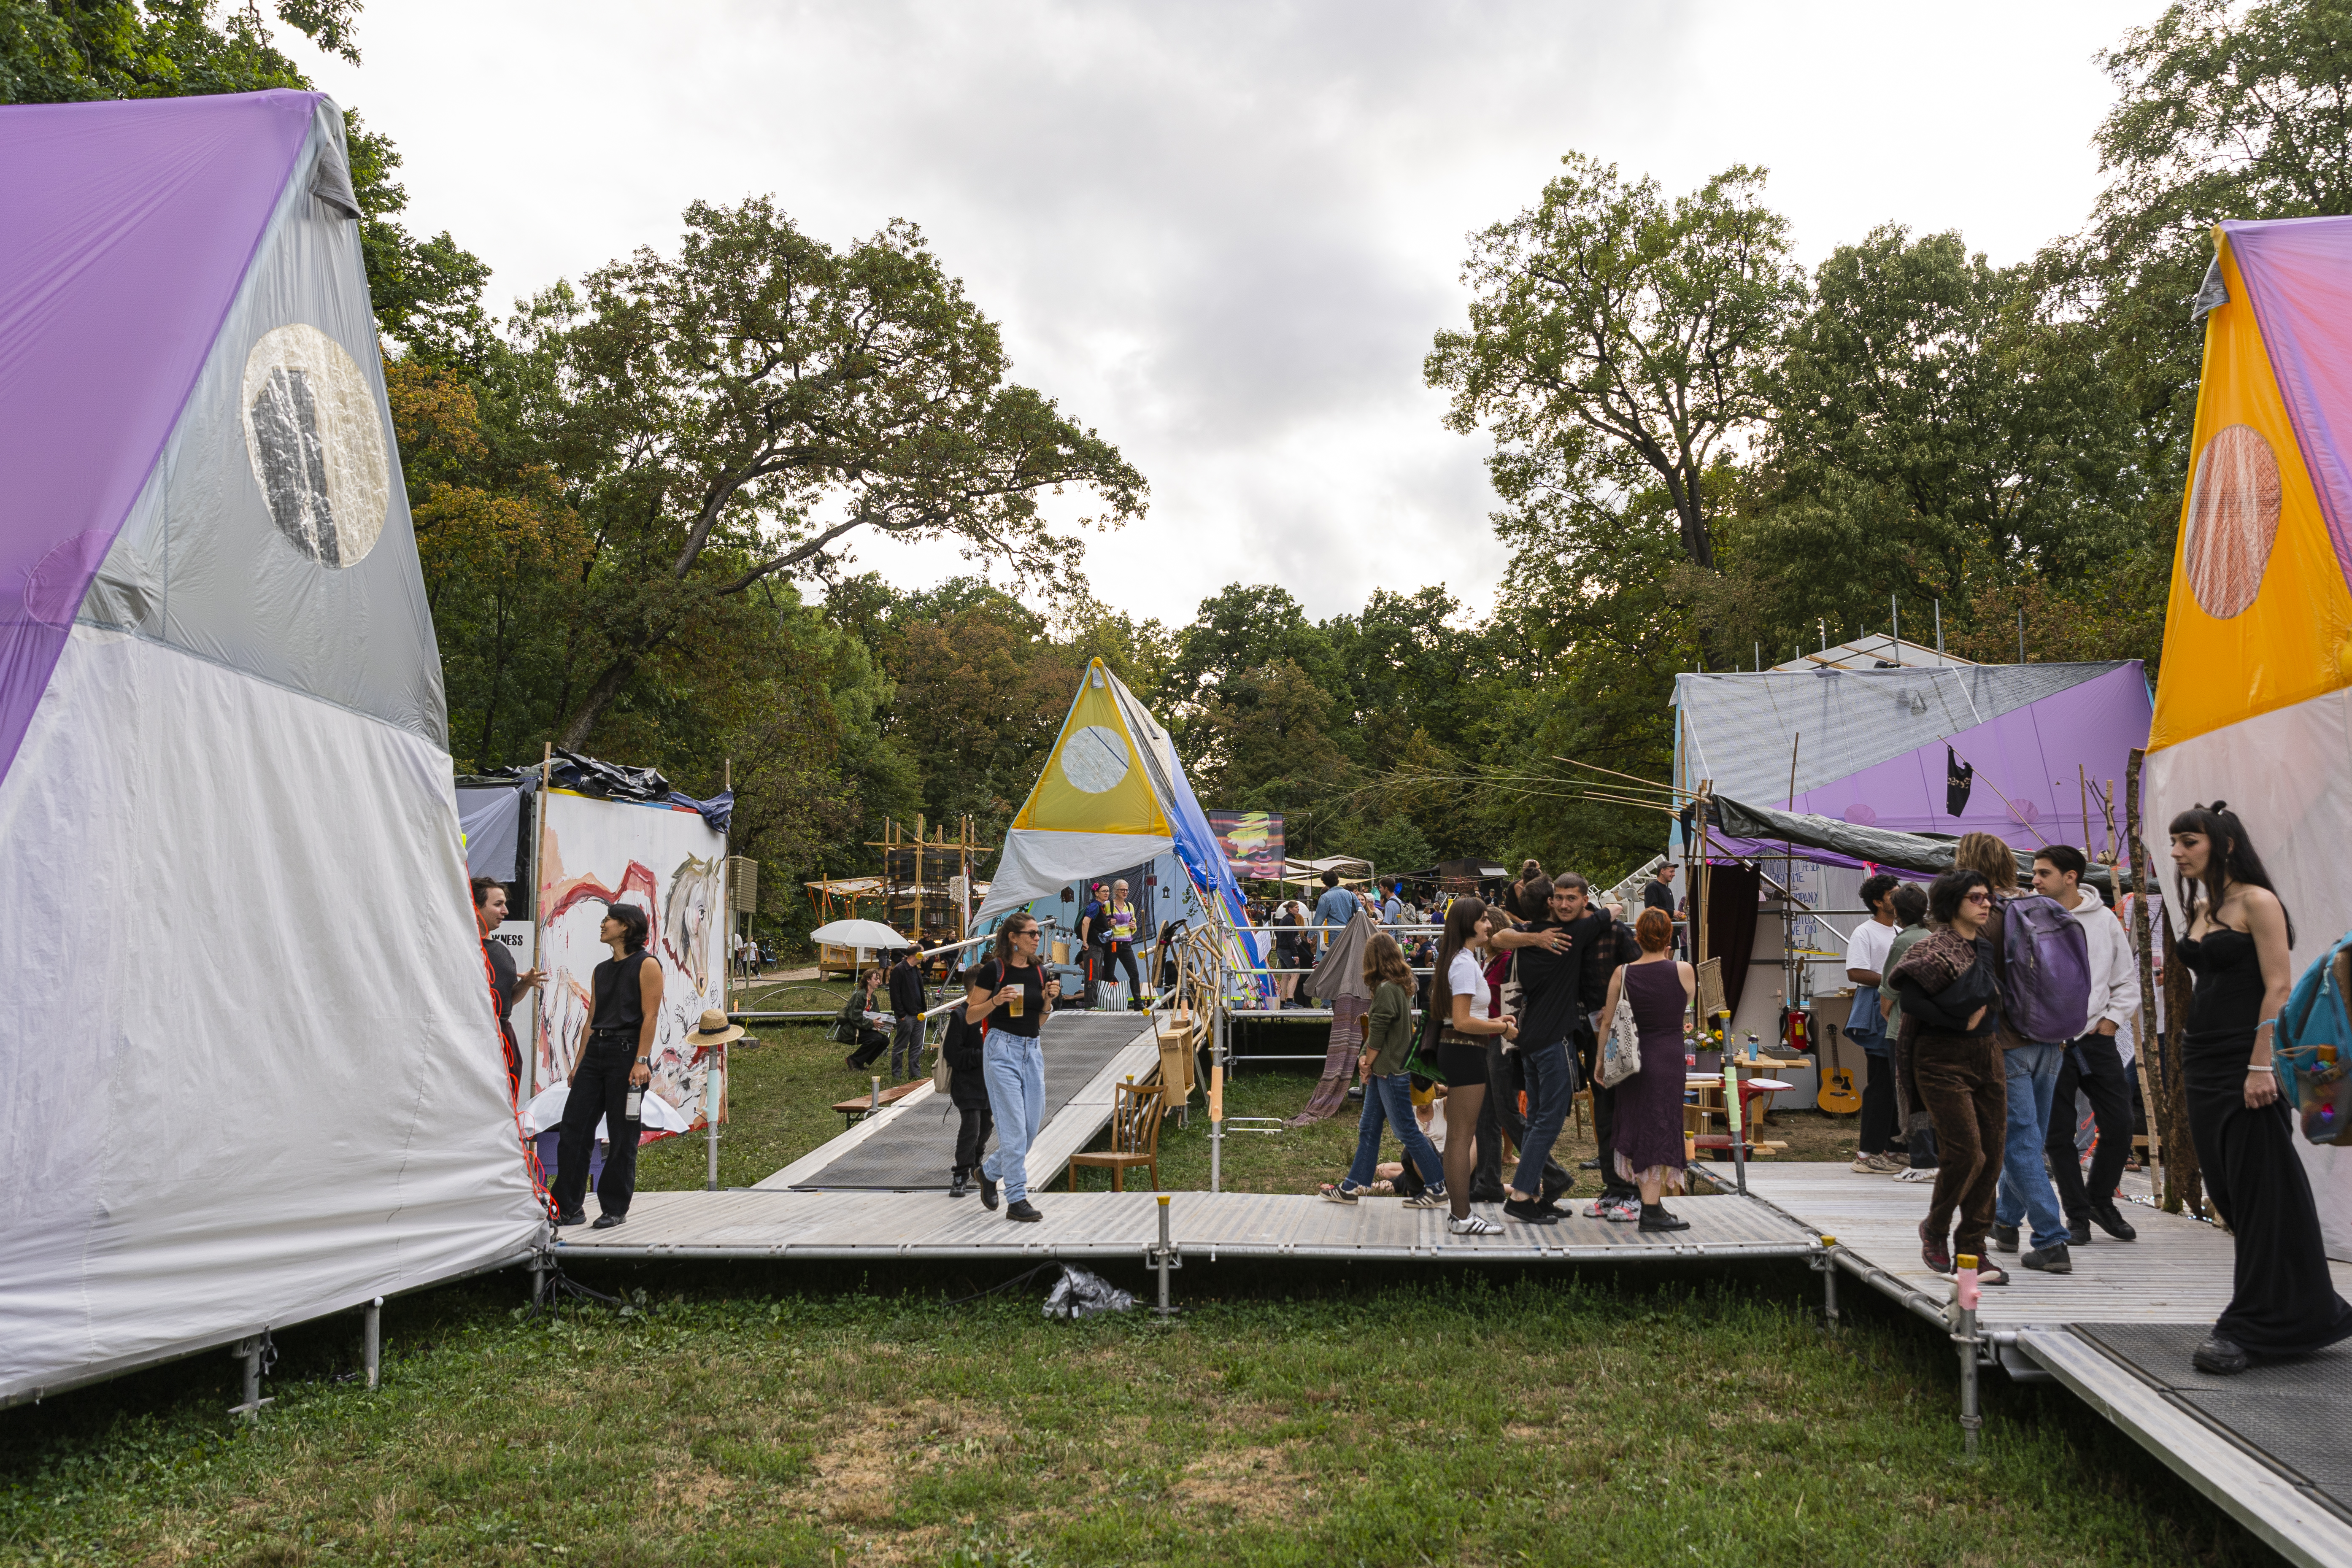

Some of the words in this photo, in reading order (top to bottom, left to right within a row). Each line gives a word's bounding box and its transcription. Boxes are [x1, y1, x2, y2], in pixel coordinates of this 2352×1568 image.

[1777, 862, 1794, 873] BOTM
[1809, 863, 1820, 872] SEA
[1792, 872, 1805, 883] ME
[1791, 891, 1818, 904] OMPANY
[1805, 925, 1816, 934] ON
[490, 934, 523, 946] NESS
